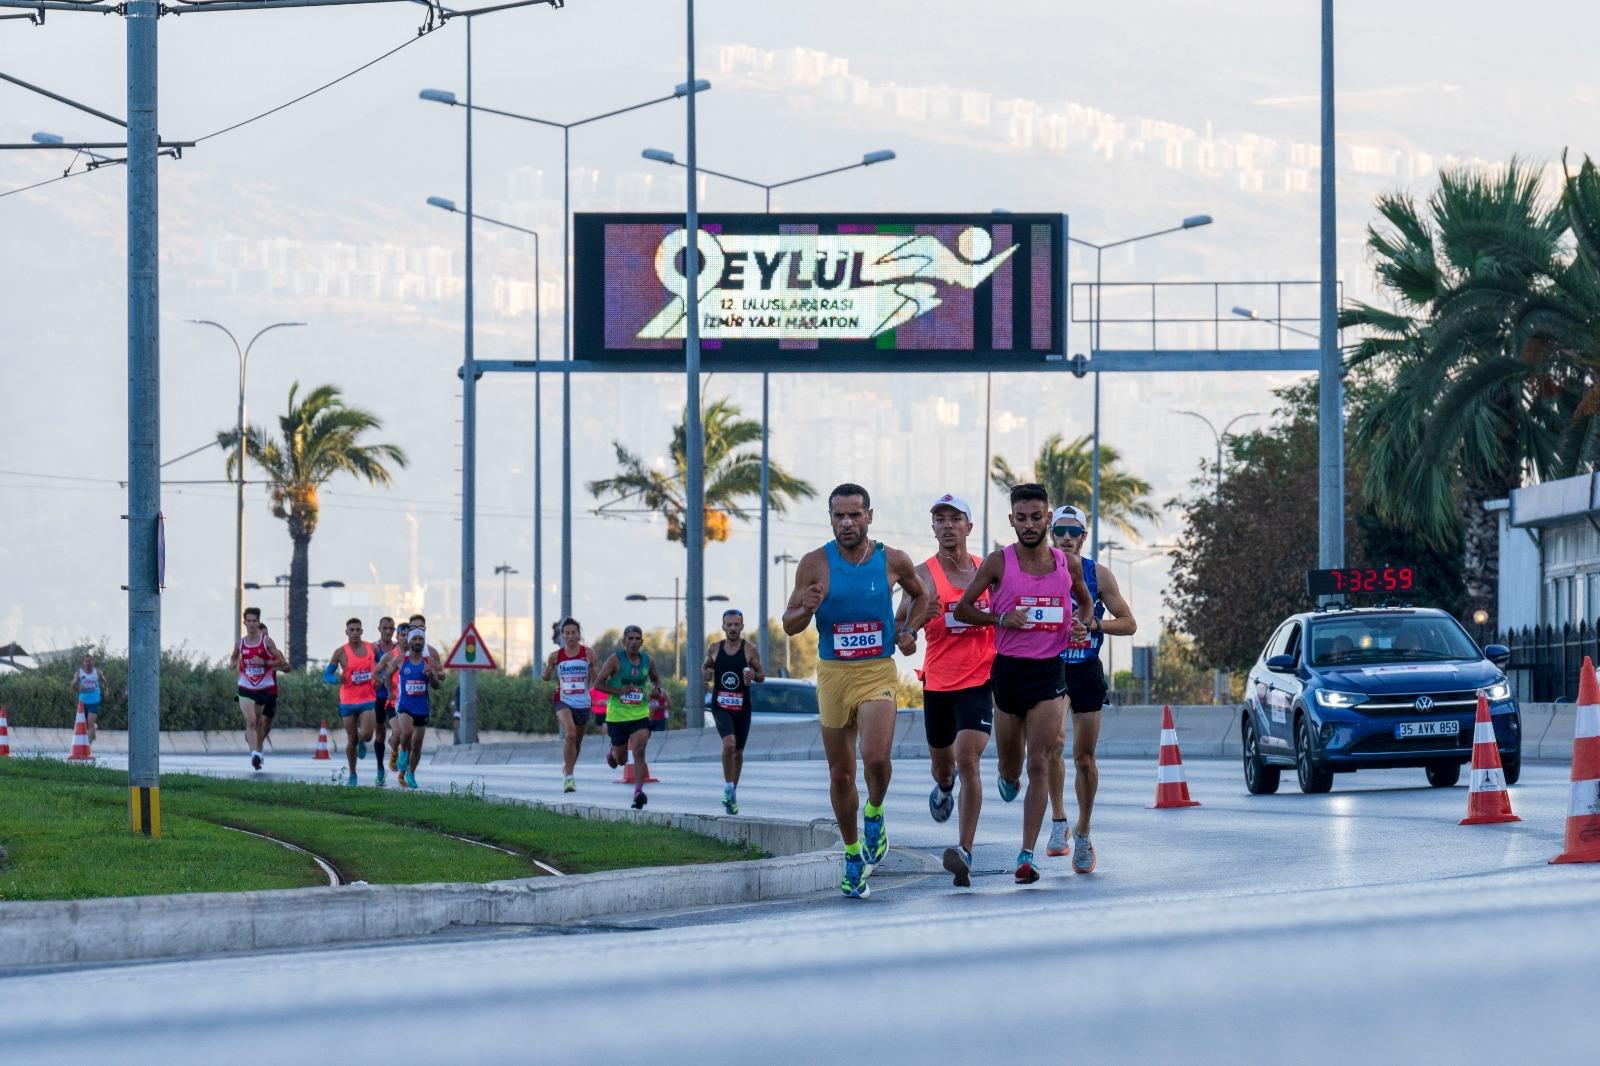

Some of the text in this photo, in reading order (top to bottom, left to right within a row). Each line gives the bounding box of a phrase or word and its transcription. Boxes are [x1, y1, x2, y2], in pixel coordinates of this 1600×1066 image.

[1035, 609, 1044, 620] 8
[840, 635, 876, 647] 3286
[1401, 721, 1458, 735] 35 AVK 859
